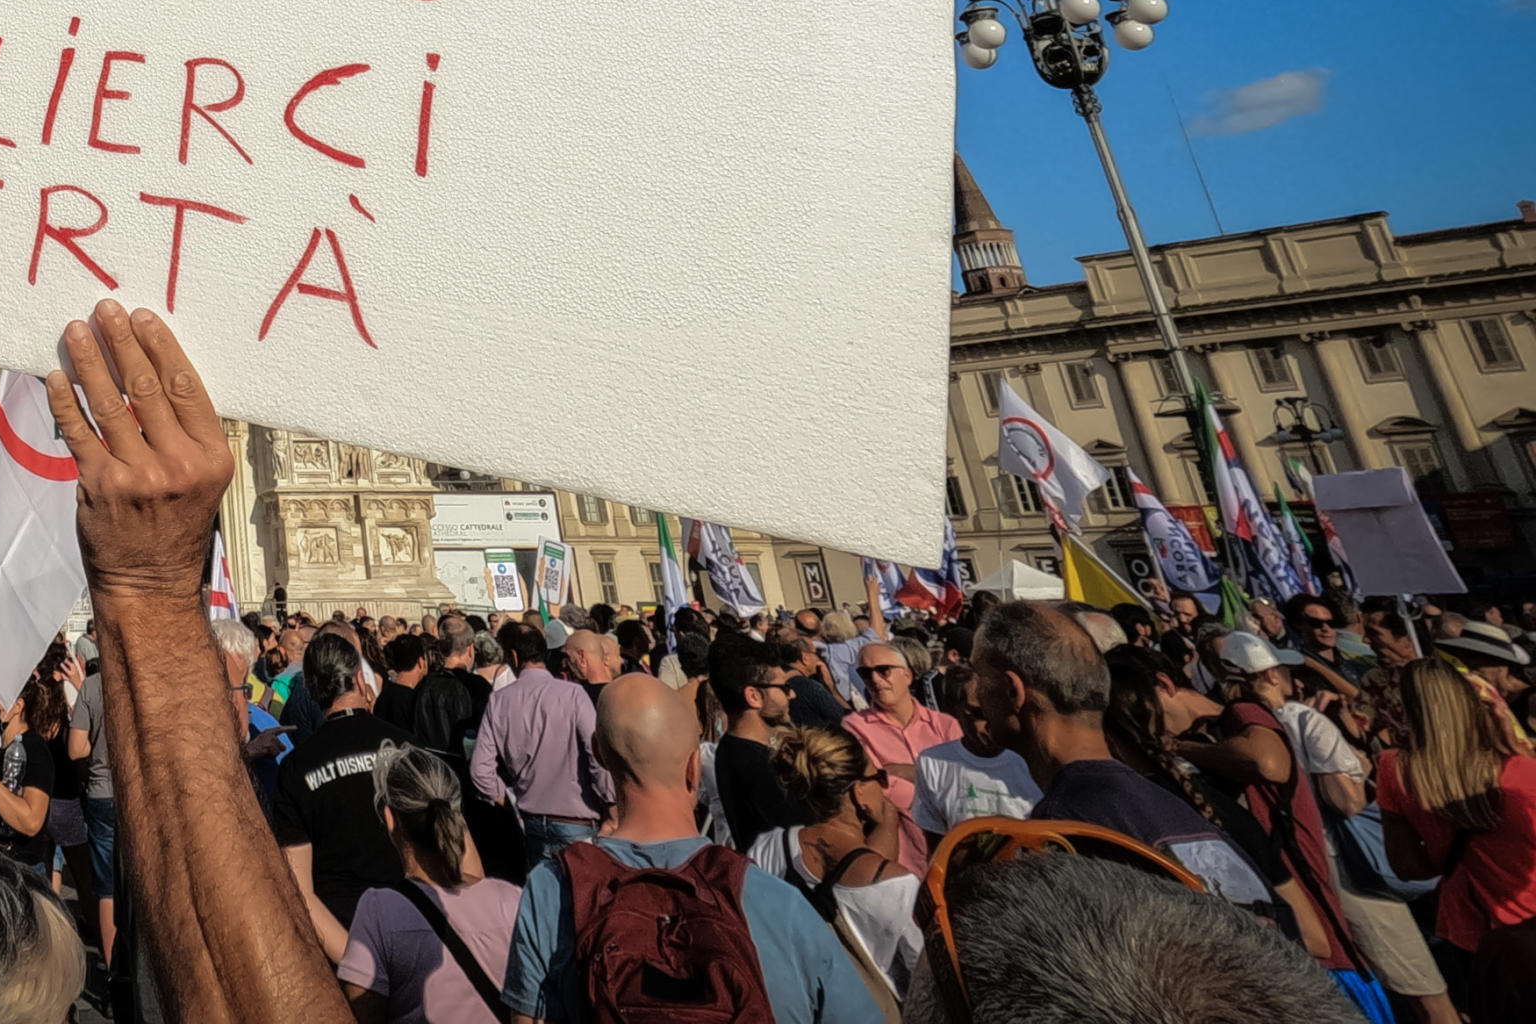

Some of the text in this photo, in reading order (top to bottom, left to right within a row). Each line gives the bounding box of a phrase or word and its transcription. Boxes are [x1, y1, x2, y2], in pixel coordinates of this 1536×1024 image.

[460, 523, 503, 531] CATTEDRALE
[305, 763, 336, 790] WALT
[336, 753, 377, 776] DISNEY
